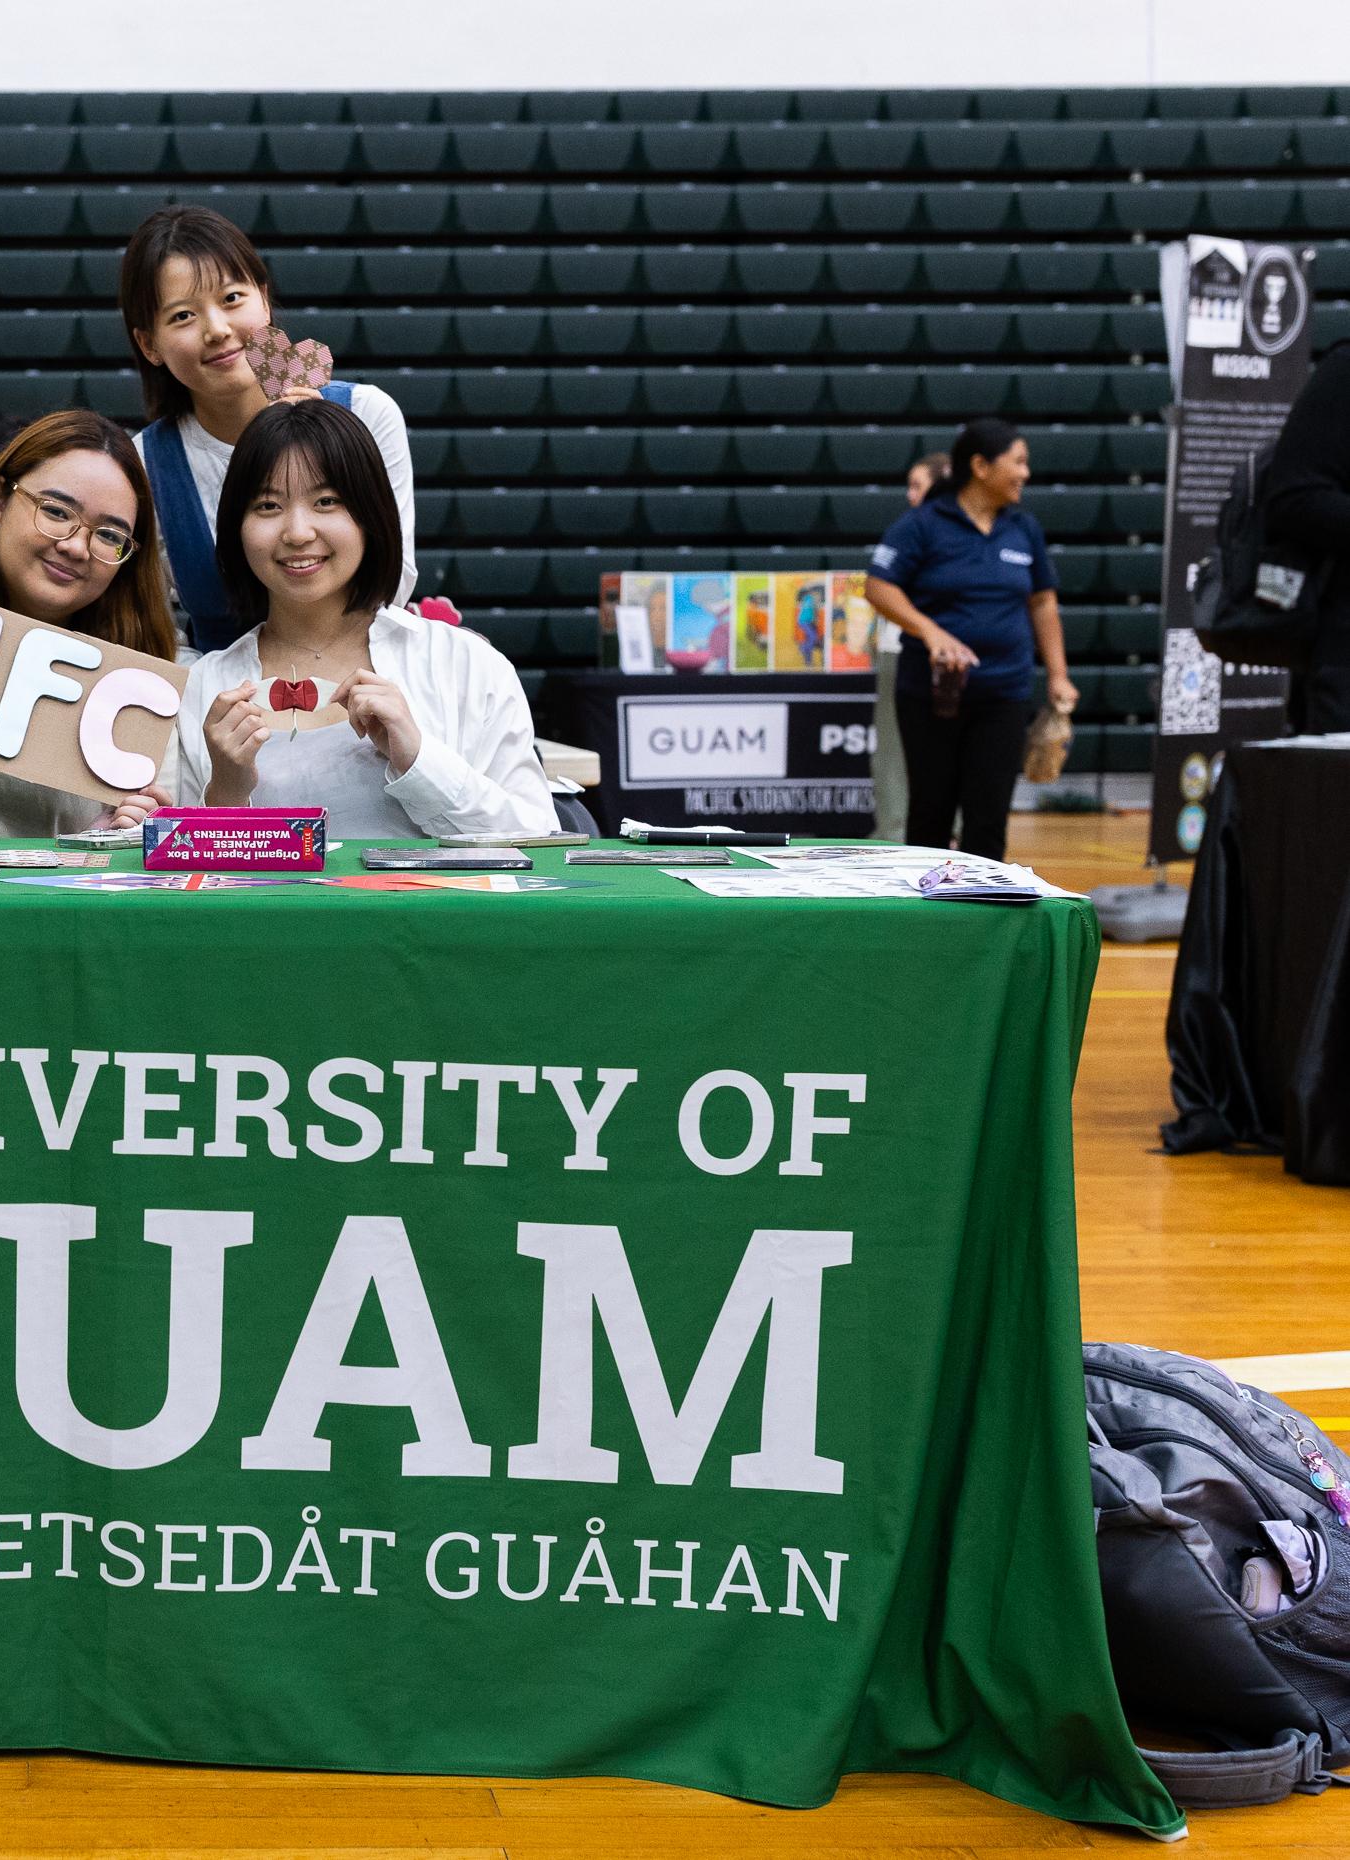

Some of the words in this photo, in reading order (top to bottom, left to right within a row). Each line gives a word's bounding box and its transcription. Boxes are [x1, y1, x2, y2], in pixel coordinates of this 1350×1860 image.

[649, 726, 766, 754] GUAM
[193, 830, 251, 839] PATTERNS
[254, 831, 291, 839] WASHI
[213, 840, 270, 848] JAPANESE
[303, 832, 312, 856] TUTTLE
[167, 851, 190, 860] Box
[203, 850, 214, 860] in
[217, 849, 251, 860] Paper
[254, 849, 300, 860] Origami
[678, 1070, 867, 1176] OF
[426, 1517, 850, 1622] GUÅHAN
